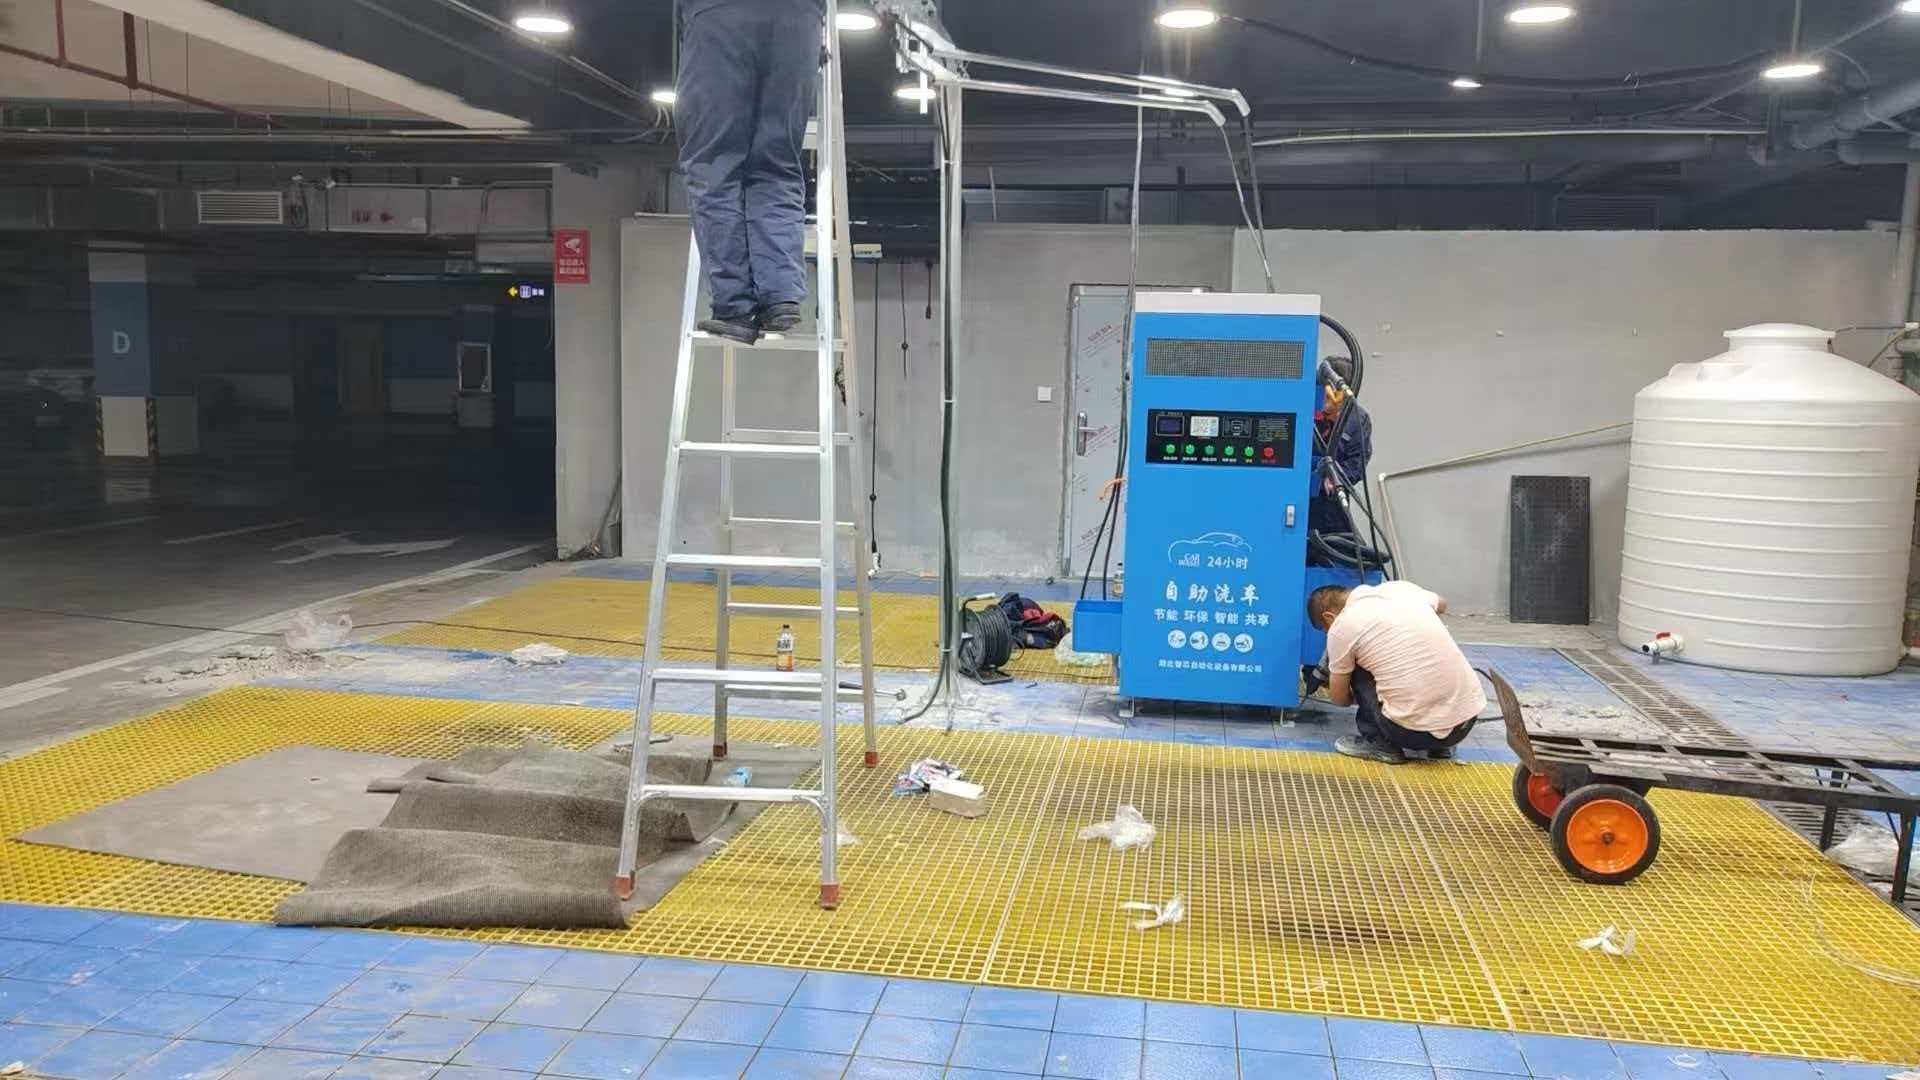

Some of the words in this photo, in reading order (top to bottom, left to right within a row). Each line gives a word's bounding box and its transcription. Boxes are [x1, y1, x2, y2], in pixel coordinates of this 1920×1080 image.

[112, 331, 130, 353] D
[1207, 556, 1249, 569] 24小时
[1166, 582, 1259, 606] 自助洗车
[1154, 609, 1178, 622] 节能
[1184, 610, 1209, 623] 环保
[1215, 612, 1239, 625] 智能
[1245, 614, 1270, 626] 共享
